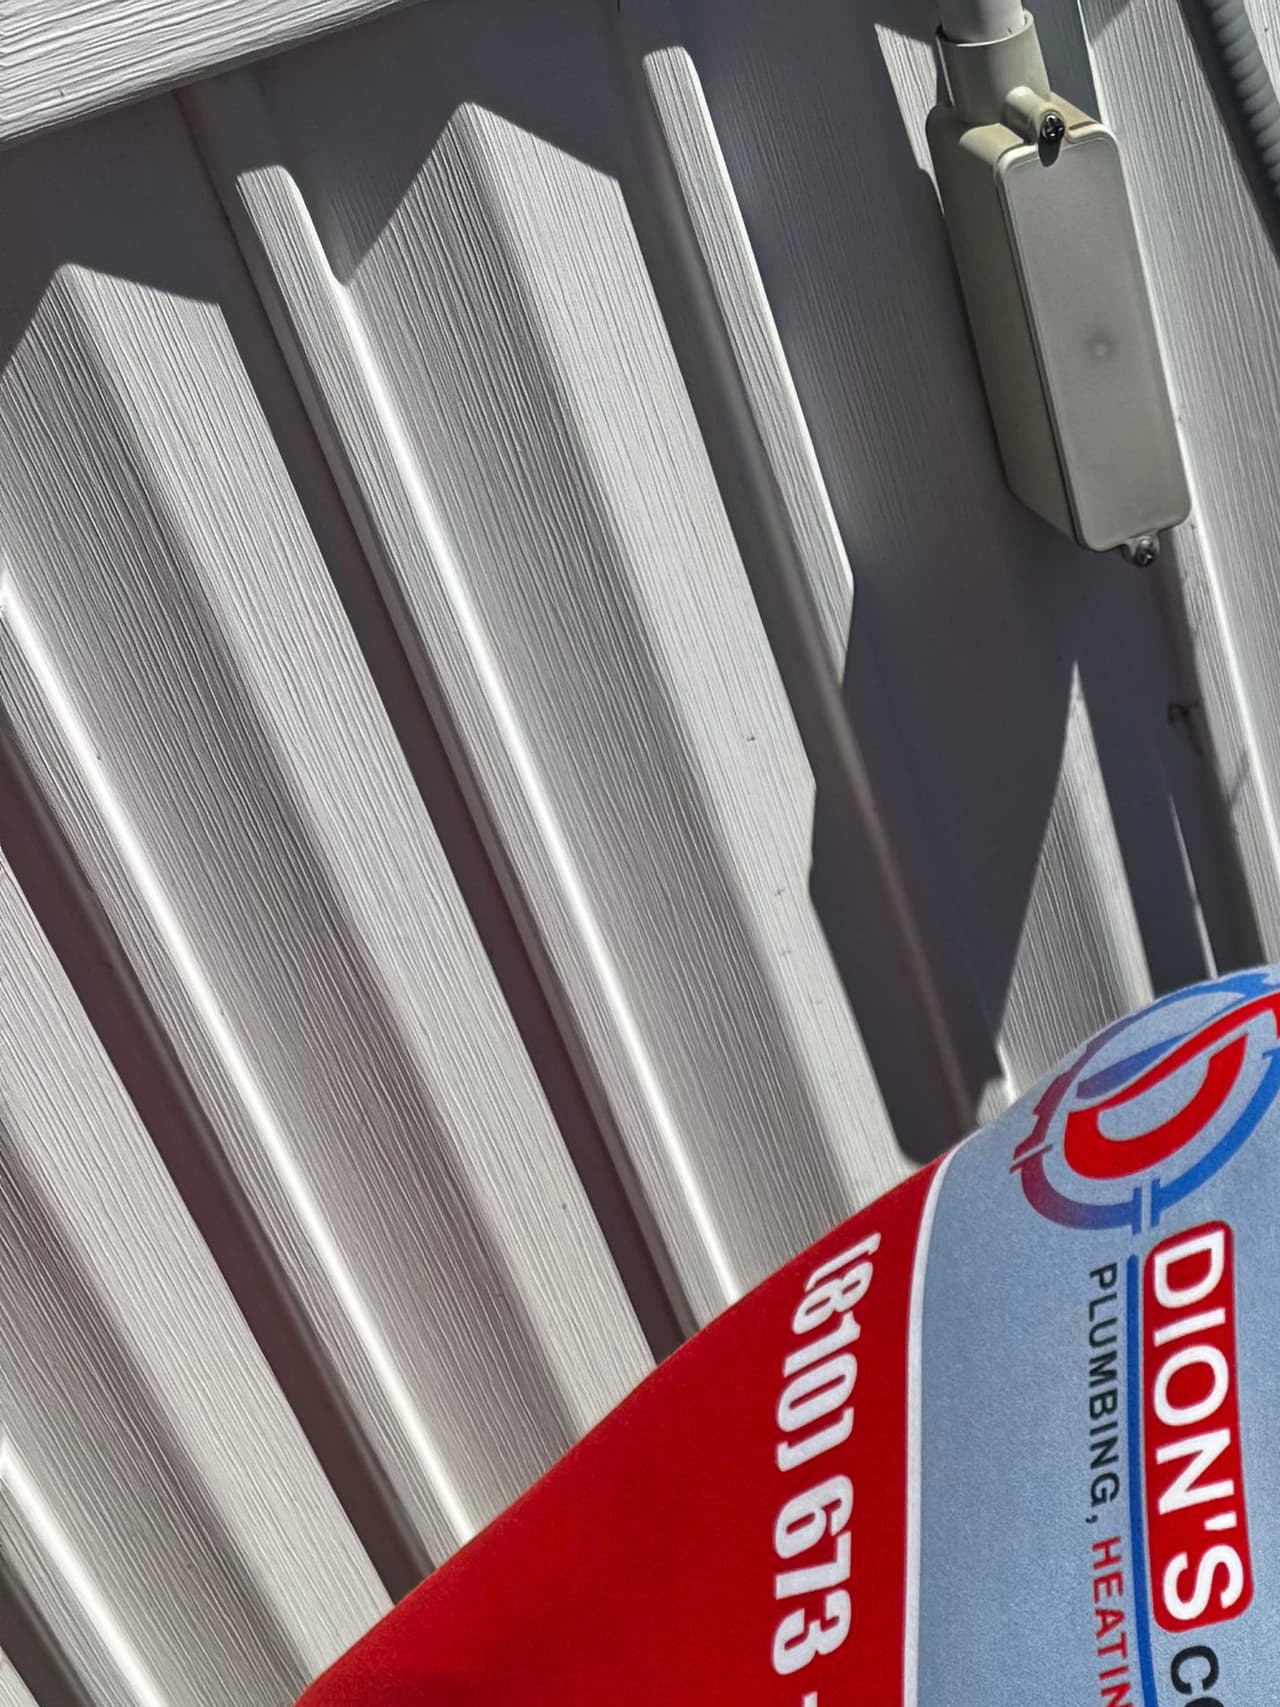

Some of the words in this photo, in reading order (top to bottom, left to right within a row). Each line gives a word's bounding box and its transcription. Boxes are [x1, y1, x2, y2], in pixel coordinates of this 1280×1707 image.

[775, 1231, 882, 1472] (810)
[1085, 1262, 1121, 1525] PLUMBING,
[1153, 1229, 1245, 1620] DION'S
[771, 1473, 855, 1677] 673
